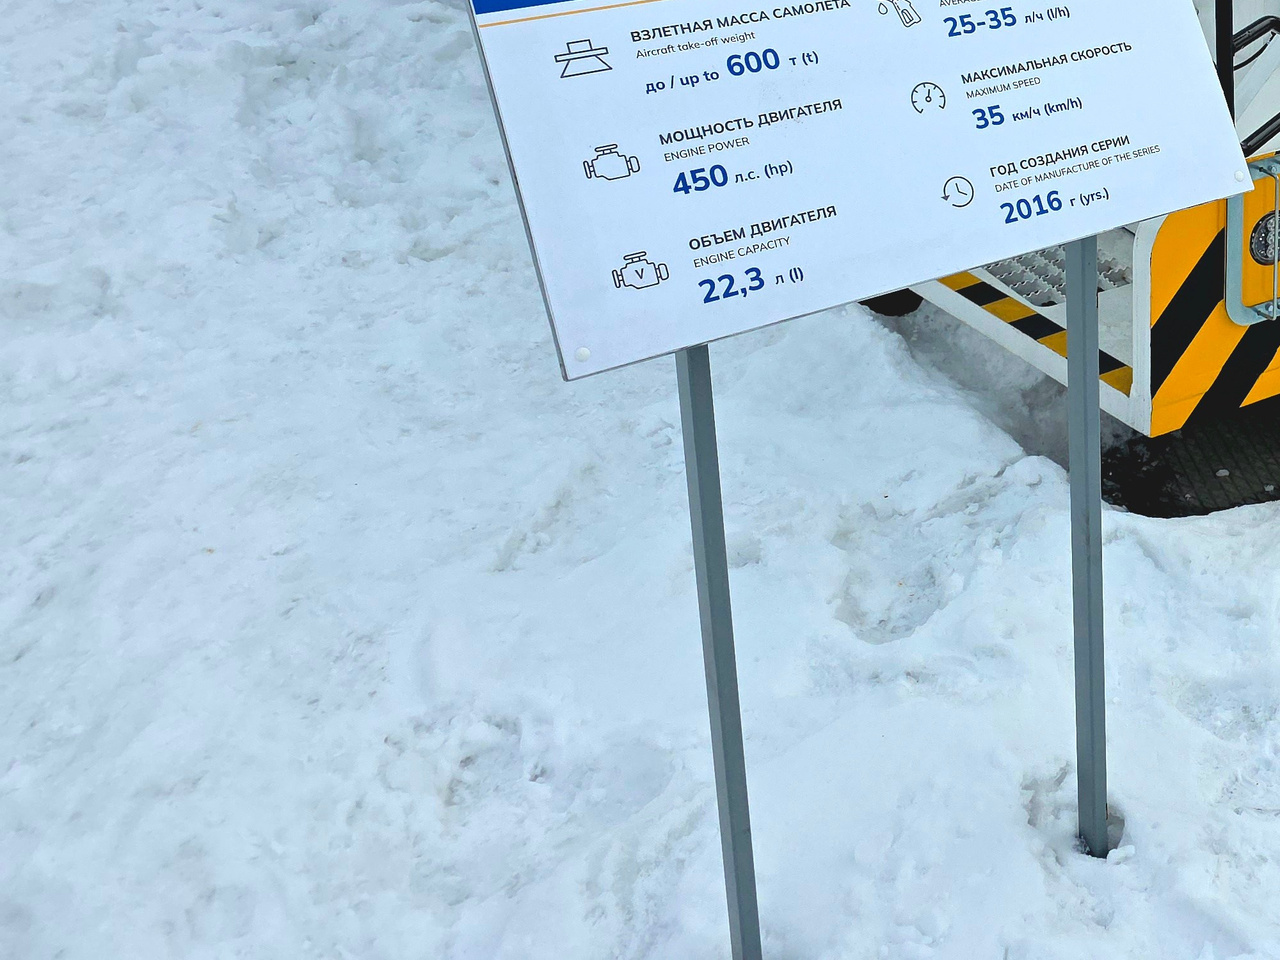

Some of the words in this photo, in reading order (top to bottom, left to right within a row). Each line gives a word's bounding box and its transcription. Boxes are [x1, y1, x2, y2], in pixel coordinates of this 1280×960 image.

[630, 19, 714, 43] ВЗЛЕТНАЯ
[717, 10, 770, 29] МАССА
[943, 6, 1017, 37] 25-35
[1024, 10, 1044, 24] л/ч
[1046, 5, 1071, 22] (l/h)
[635, 43, 675, 59] Aircraft
[677, 37, 718, 52] take-off
[720, 31, 756, 47] weight
[645, 78, 666, 94] до
[680, 74, 700, 89] up
[702, 69, 720, 82] to
[726, 48, 780, 76] 600
[801, 51, 819, 67] (t)
[961, 54, 1068, 85] МАКСИМАЛЬНАЯ
[1070, 42, 1132, 62] СКОРОСТЬ
[966, 83, 1011, 99] MAXIMUM
[1012, 77, 1041, 91] SPEED
[659, 118, 754, 146] МОЩНОСТЬ
[757, 98, 843, 128] ДВИГАТЕЛЯ
[972, 104, 1005, 129] 35
[1012, 107, 1041, 122] км/ч
[1044, 97, 1083, 117] (km/h)
[664, 146, 706, 162] ENGINE
[708, 137, 750, 154] POWER
[989, 161, 1019, 178] ГОД
[1019, 145, 1089, 171] СОЗДАНИЯ
[1091, 135, 1130, 153] СЕРИИ
[672, 164, 728, 196] 450
[734, 168, 760, 185] л.с.
[764, 160, 793, 180] (hp)
[995, 180, 1019, 193] DATE
[1020, 176, 1034, 187] OF
[1035, 160, 1101, 183] MANUFACTURE
[1102, 156, 1113, 167] OF
[1113, 152, 1132, 163] THE
[1133, 144, 1161, 159] SERIES
[1000, 190, 1063, 224] 2016
[1079, 187, 1110, 206] (yrs.)
[688, 227, 747, 251] ОБЪЕМ
[750, 205, 837, 237] ДВИГАТЕЛЯ
[693, 250, 735, 268] ENGINE
[737, 236, 791, 258] CAPACITY
[698, 266, 766, 304] 22,3
[789, 266, 804, 283] (l)
